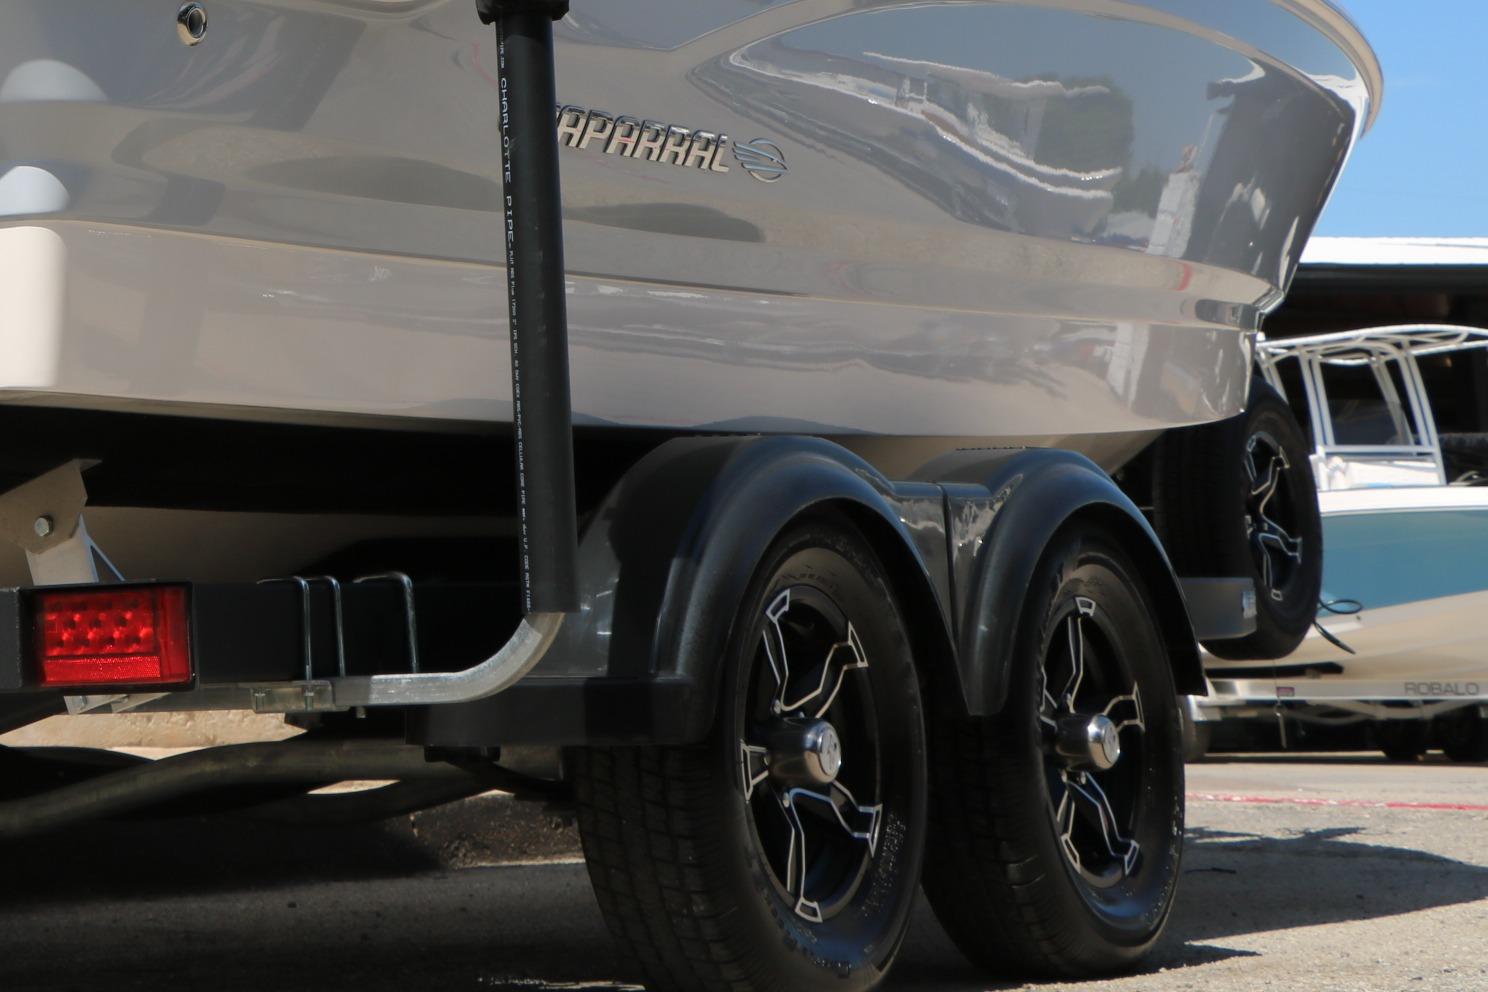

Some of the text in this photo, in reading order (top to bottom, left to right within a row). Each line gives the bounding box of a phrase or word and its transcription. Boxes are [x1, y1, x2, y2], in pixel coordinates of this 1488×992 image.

[500, 77, 511, 184] CHARLOTTE
[556, 104, 730, 174] APARRAL
[1403, 681, 1480, 696] ROBALO
